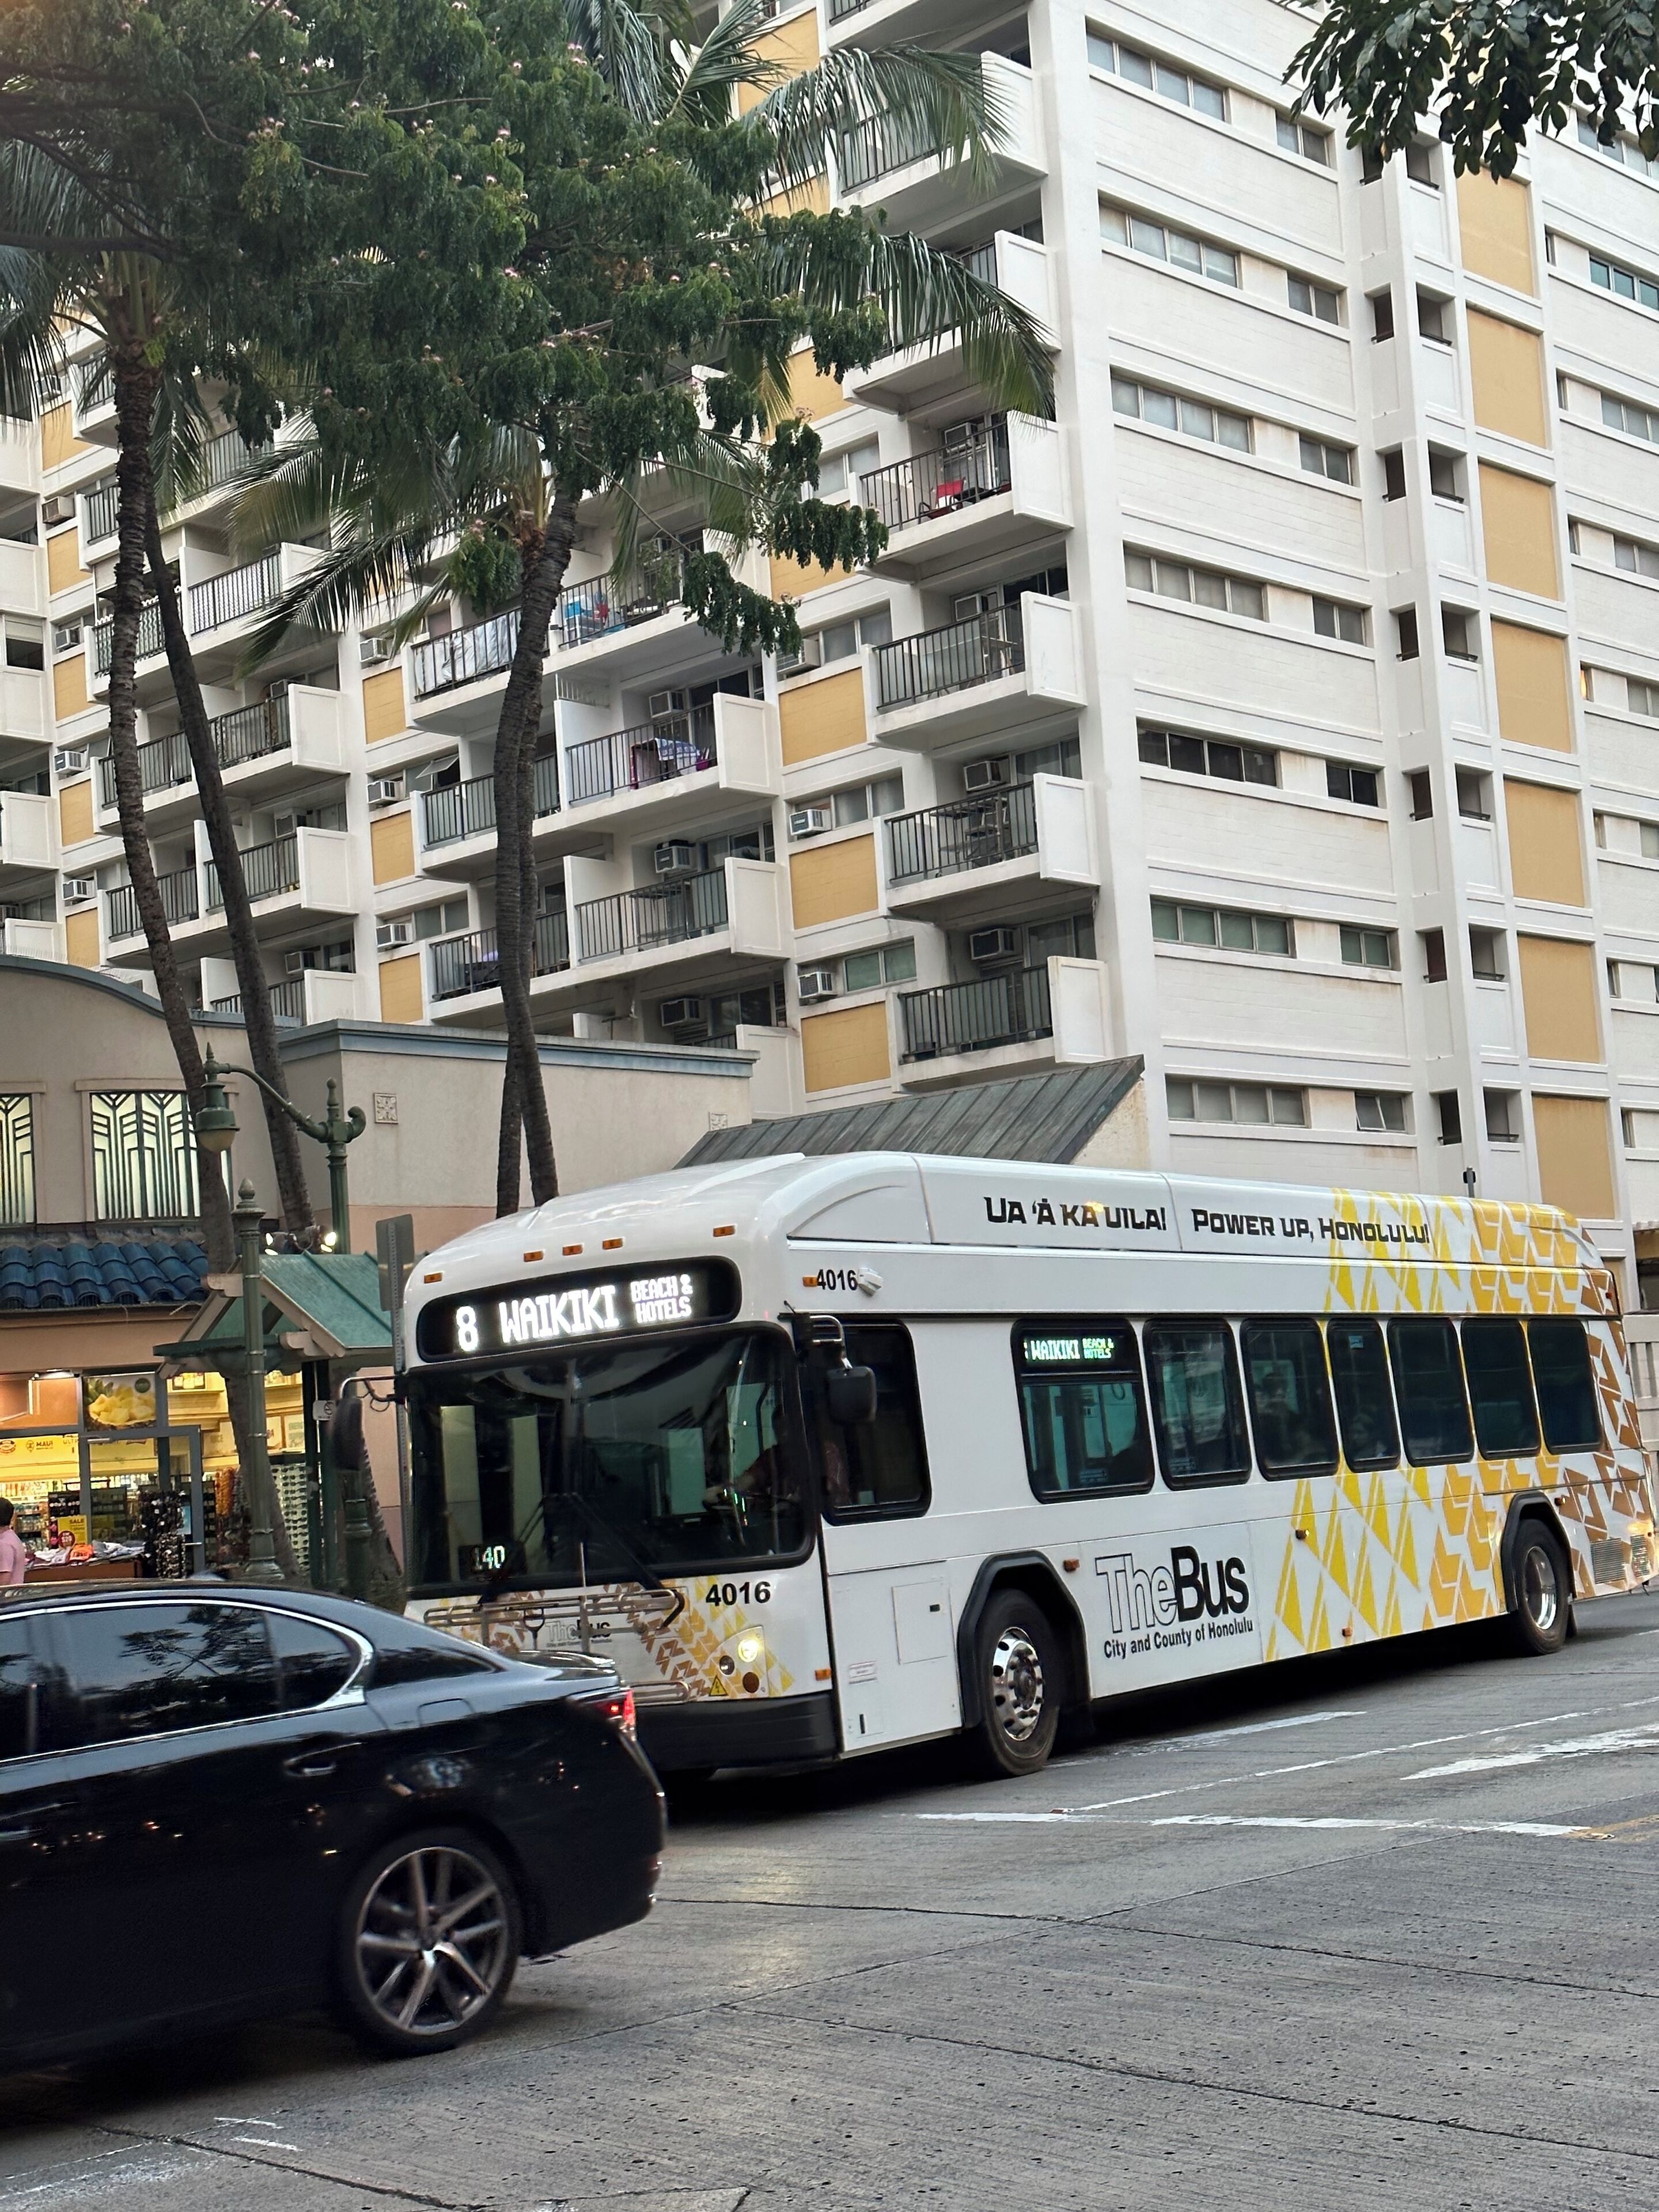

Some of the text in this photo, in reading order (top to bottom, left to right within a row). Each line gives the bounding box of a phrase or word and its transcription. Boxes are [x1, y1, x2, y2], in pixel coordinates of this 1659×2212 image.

[631, 1274, 693, 1302] BEACH &
[817, 1269, 858, 1291] 4016
[456, 1285, 620, 1351] 8 WAIKIKI
[636, 1296, 692, 1323] HOTELS
[1031, 1339, 1080, 1360] WAIKIKI
[1082, 1338, 1106, 1349] BEACH
[1084, 1348, 1111, 1359] HOTELS
[706, 1581, 771, 1607] 4016
[1094, 1546, 1249, 1634] TheBus
[1104, 1616, 1253, 1660] City and County of Honolulu
